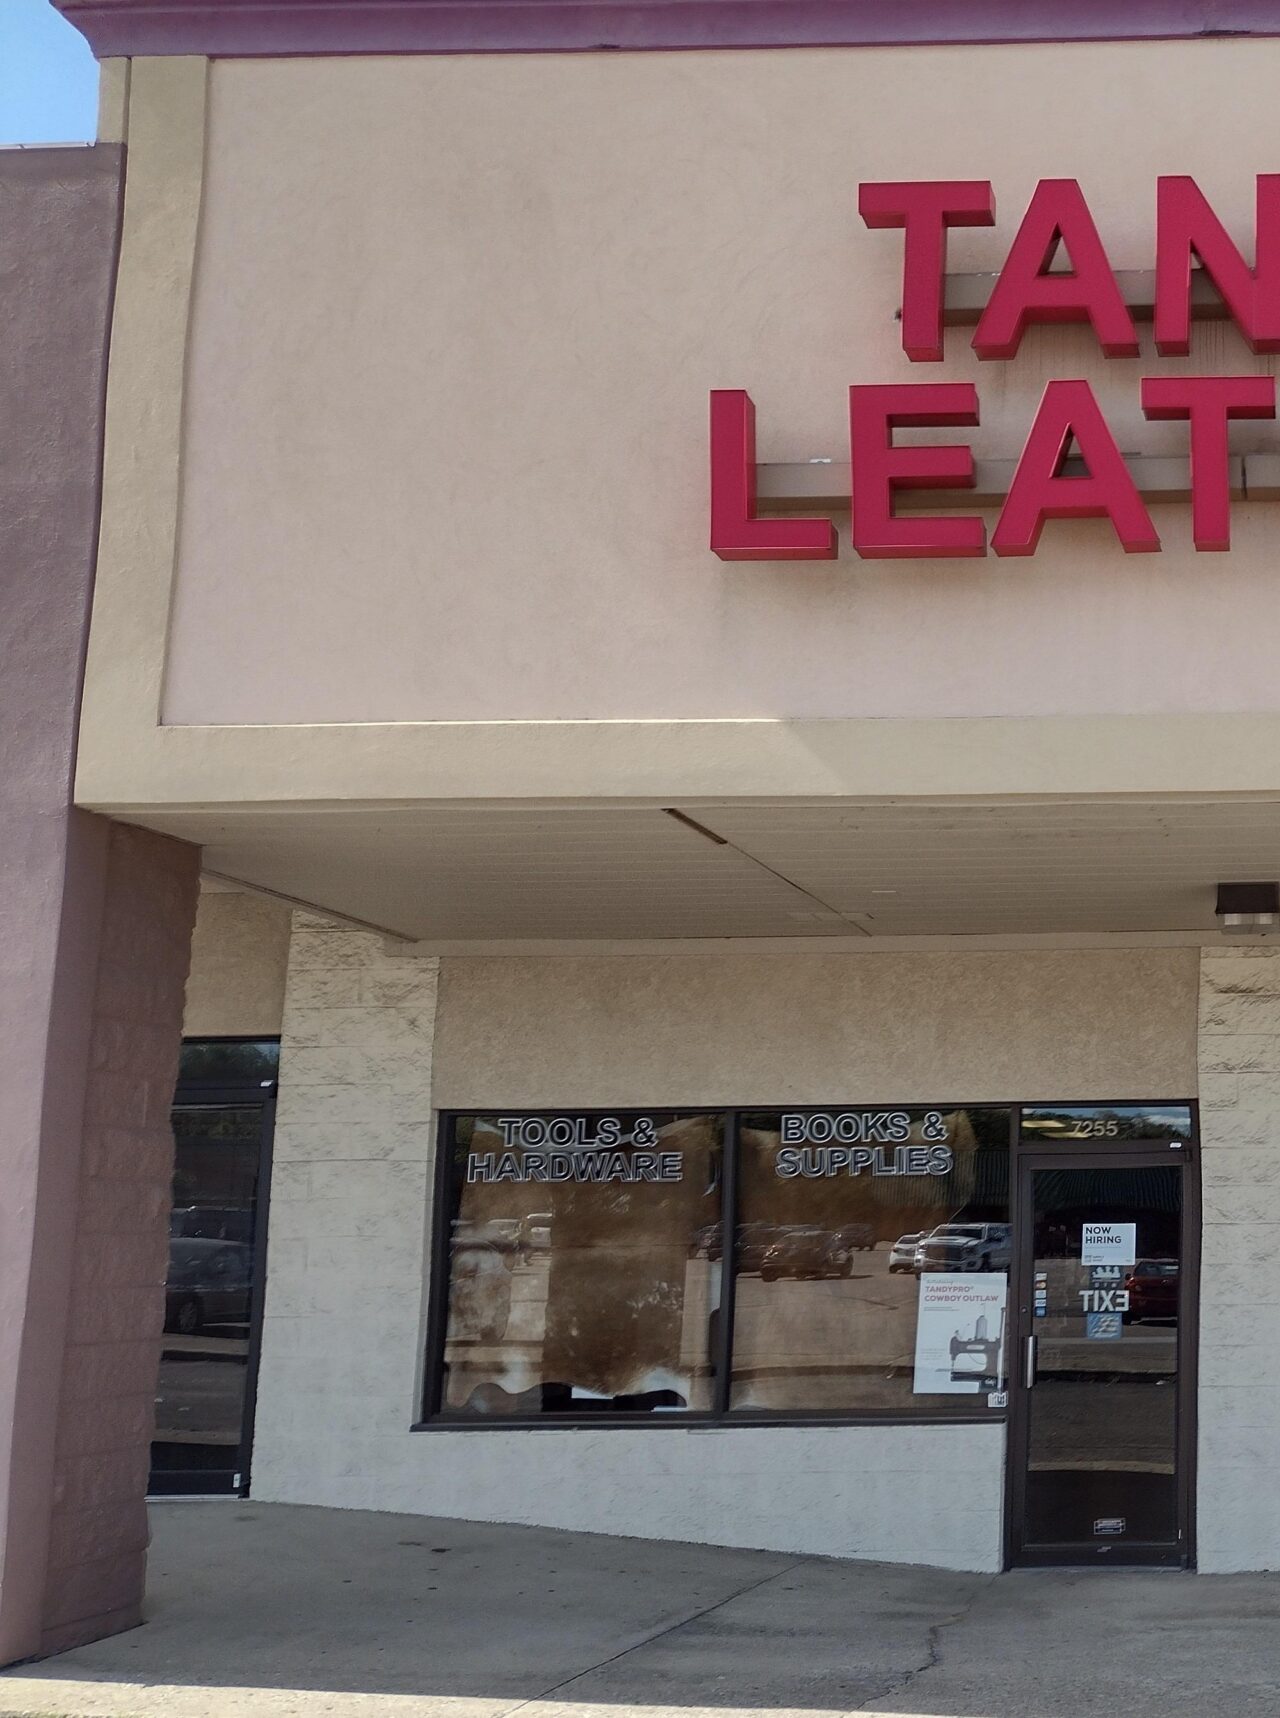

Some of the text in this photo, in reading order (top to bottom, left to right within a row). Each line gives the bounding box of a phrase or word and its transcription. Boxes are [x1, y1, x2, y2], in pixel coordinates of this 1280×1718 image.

[498, 1117, 659, 1148] TOOLS &
[781, 1111, 949, 1144] BOOKS &
[1071, 1120, 1119, 1137] 7255
[467, 1151, 683, 1183] HARDWARE
[775, 1145, 953, 1179] SUPPLIES
[1085, 1226, 1112, 1235] NOW
[1085, 1236, 1122, 1244] HIRING
